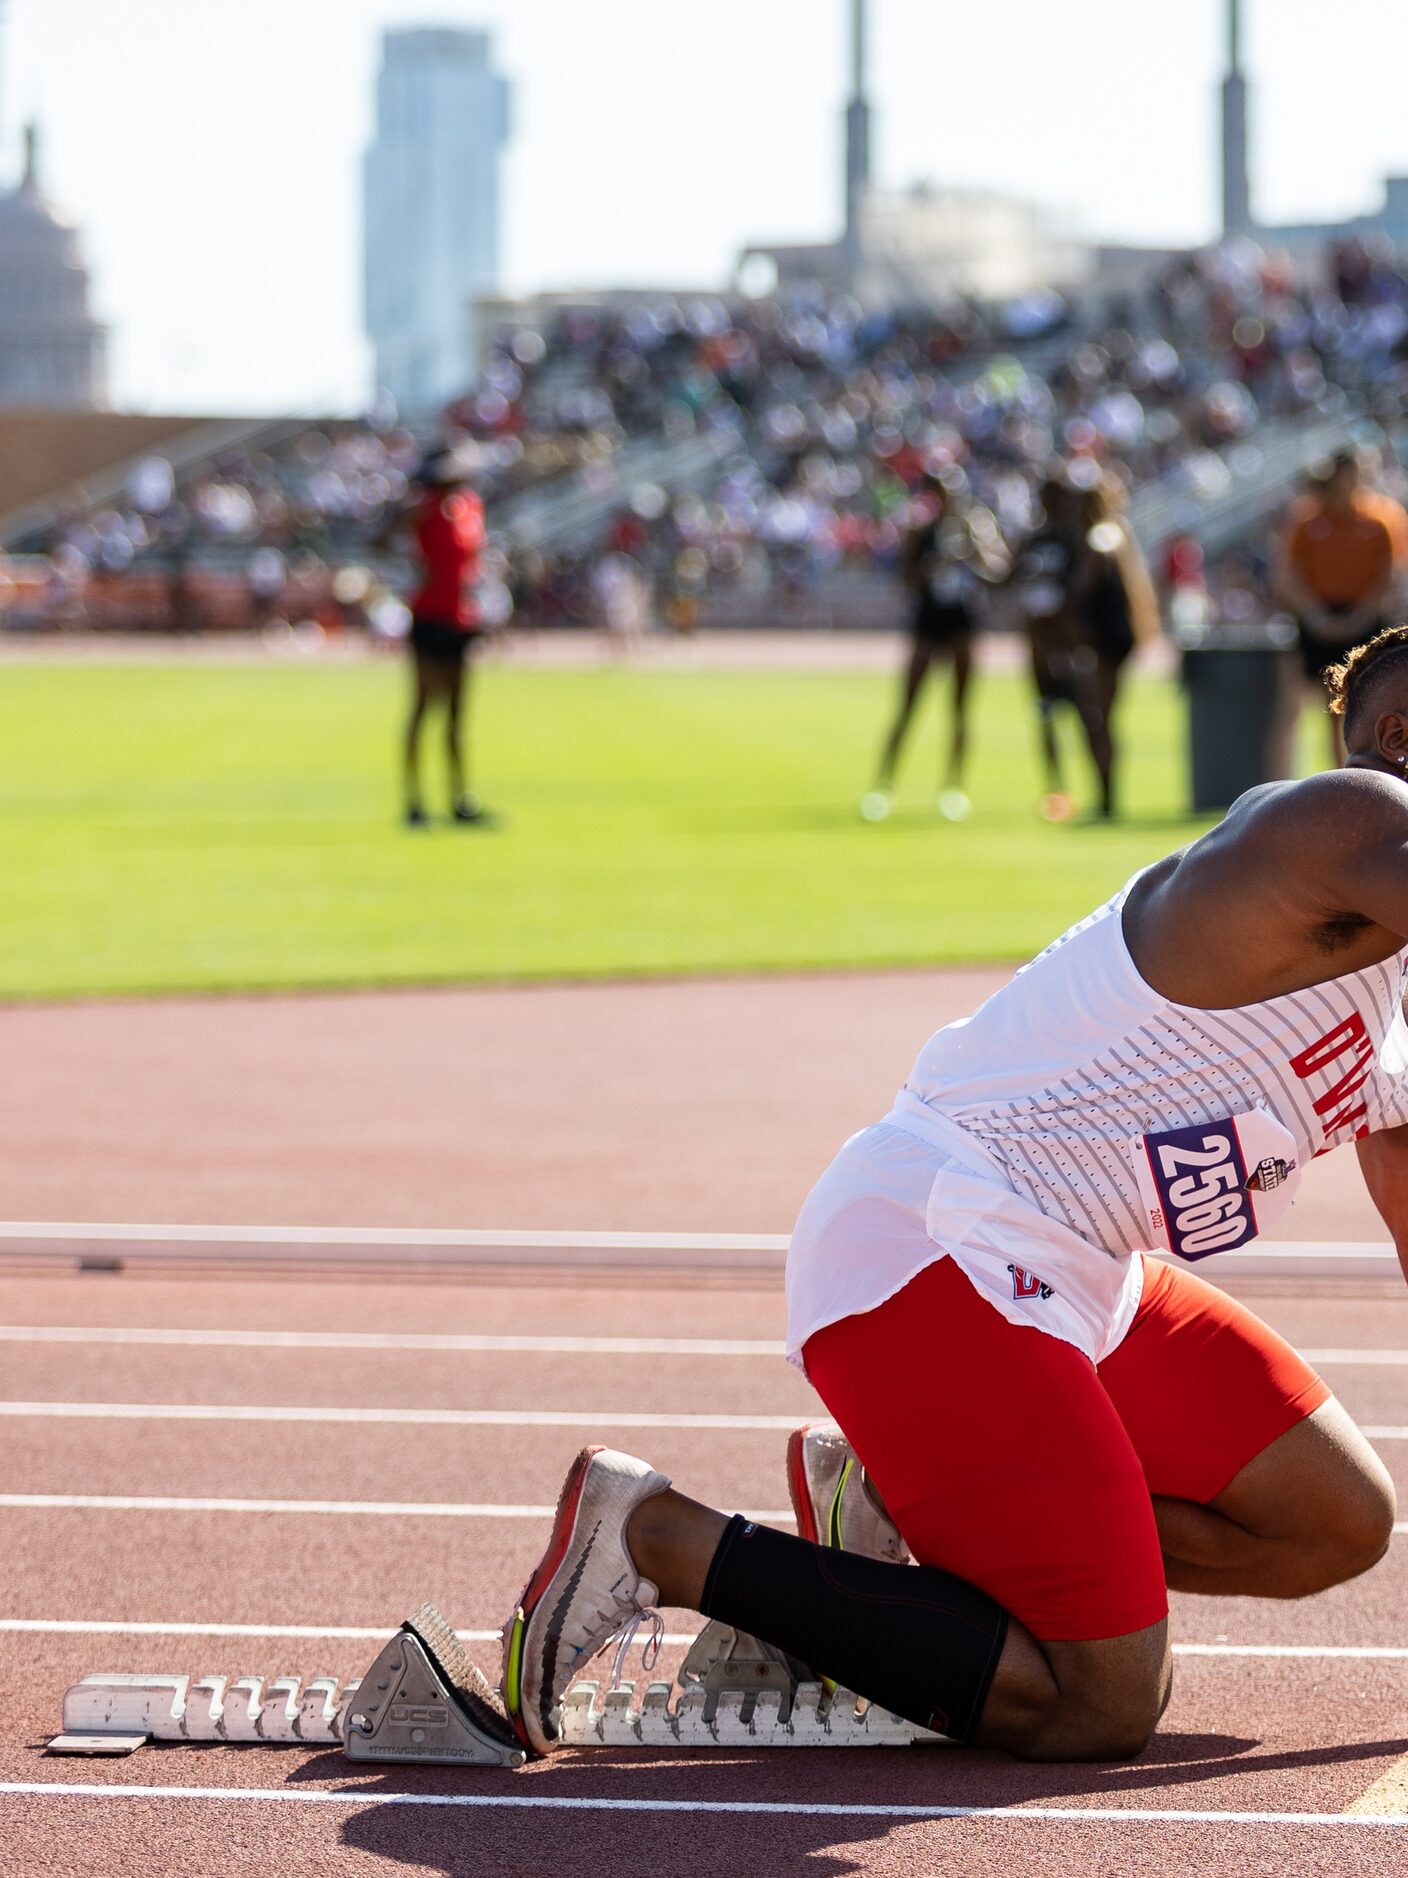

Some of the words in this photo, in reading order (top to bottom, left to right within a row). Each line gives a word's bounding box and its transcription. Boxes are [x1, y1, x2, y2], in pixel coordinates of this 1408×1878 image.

[1261, 1158, 1279, 1191] STATE
[1157, 1134, 1248, 1254] 2560
[1150, 1208, 1164, 1230] 2022
[390, 1708, 448, 1724] UCS
